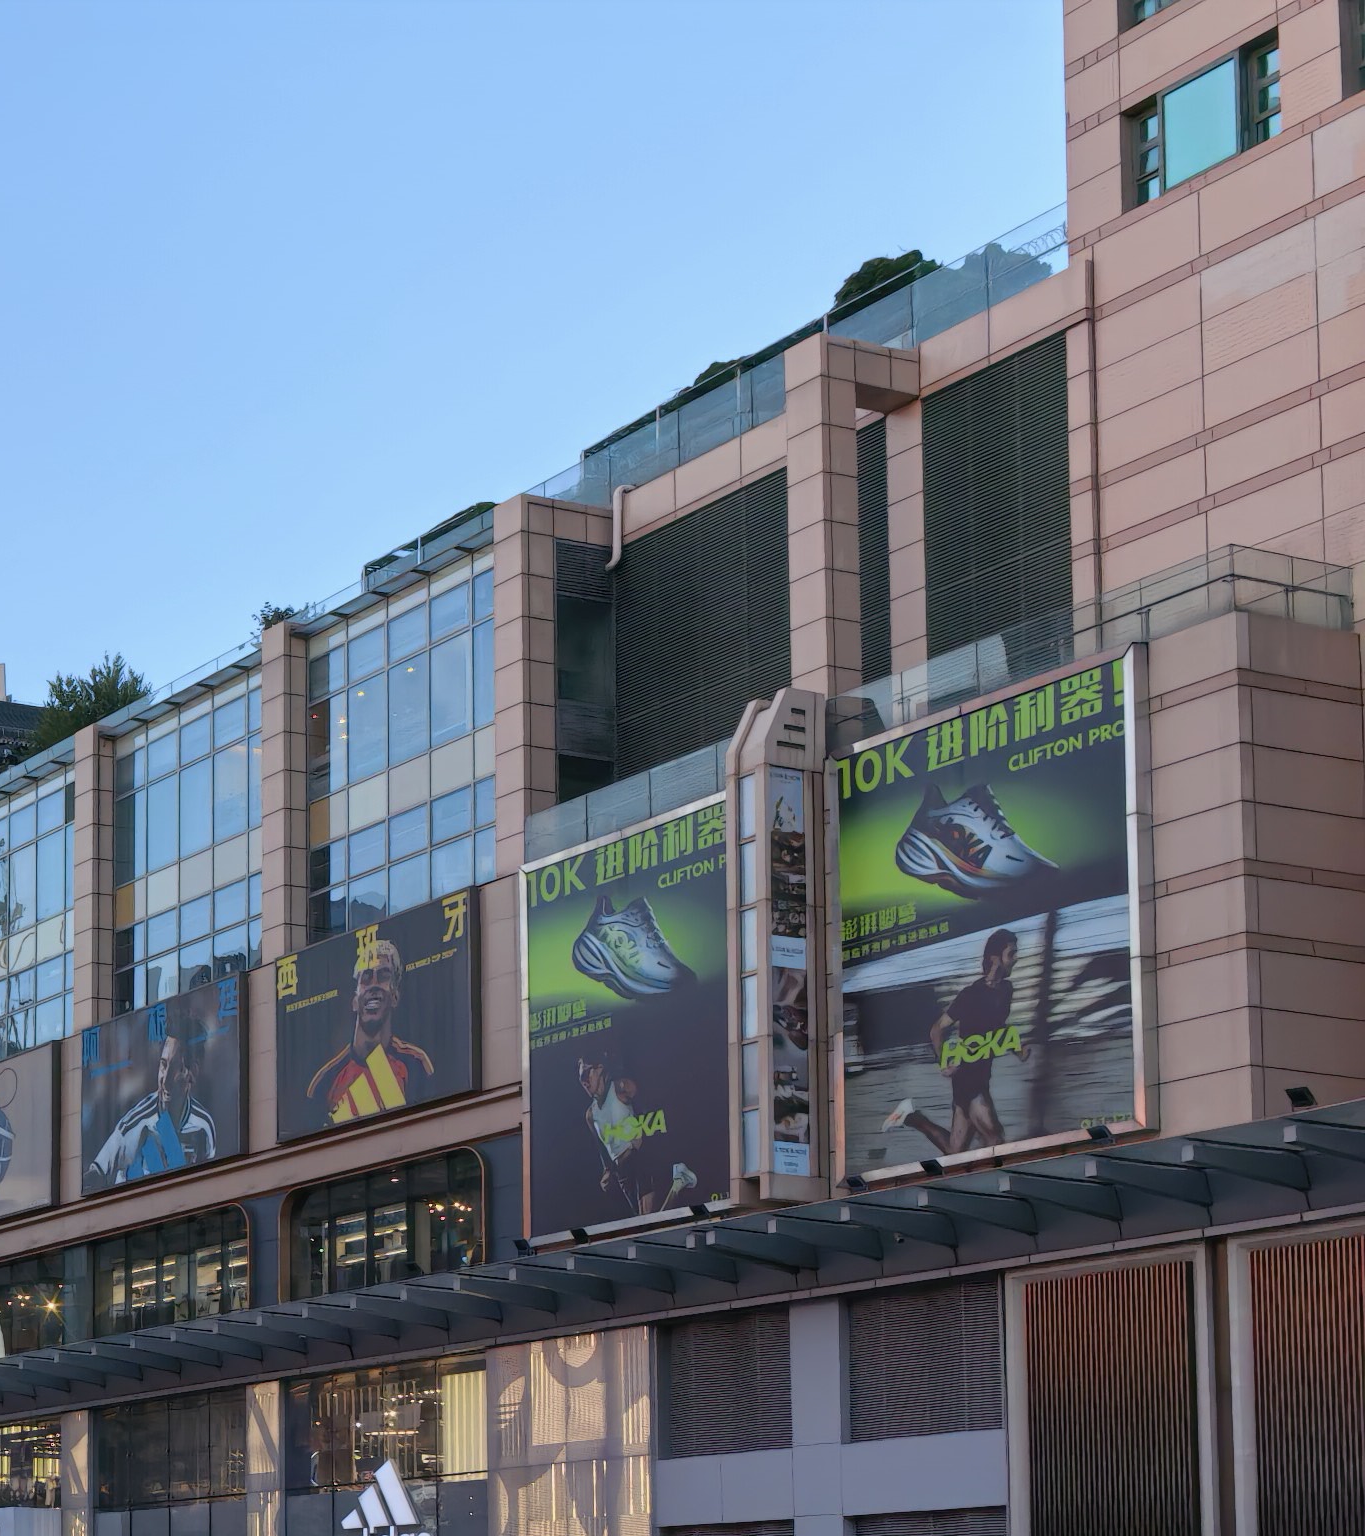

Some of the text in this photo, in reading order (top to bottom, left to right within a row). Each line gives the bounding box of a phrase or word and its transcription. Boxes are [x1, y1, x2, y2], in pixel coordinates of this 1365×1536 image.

[836, 735, 915, 800] 10K
[1008, 733, 1083, 773] CLIFTON
[527, 801, 726, 907] 10K 进阶利器
[657, 856, 715, 889] CLIFTON
[940, 1025, 1022, 1070] HOKA
[603, 1109, 667, 1144] HOKA
